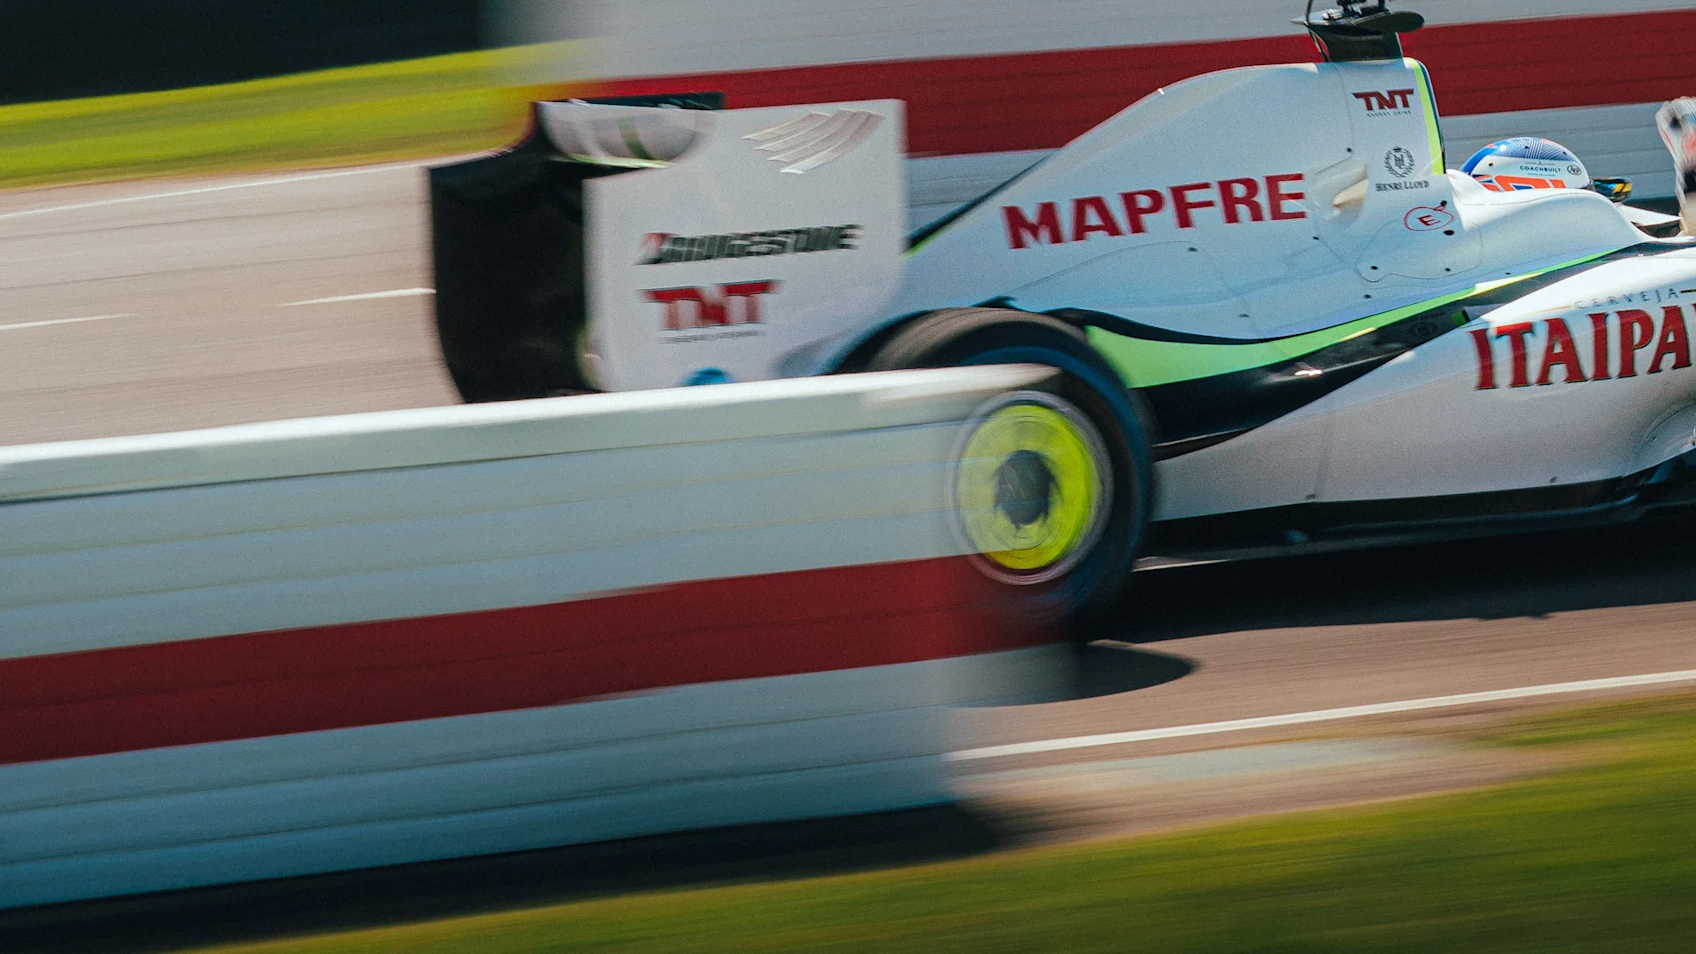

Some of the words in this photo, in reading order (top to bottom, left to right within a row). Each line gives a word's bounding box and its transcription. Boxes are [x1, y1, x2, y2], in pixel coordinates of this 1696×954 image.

[1352, 88, 1414, 111] TNT
[1519, 165, 1561, 174] COACHBUILT
[1403, 180, 1430, 190] LLOYD
[1002, 173, 1308, 249] MAPFRE
[1417, 214, 1441, 226] E
[639, 279, 783, 331] TNT
[1574, 288, 1680, 309] CERVEJA
